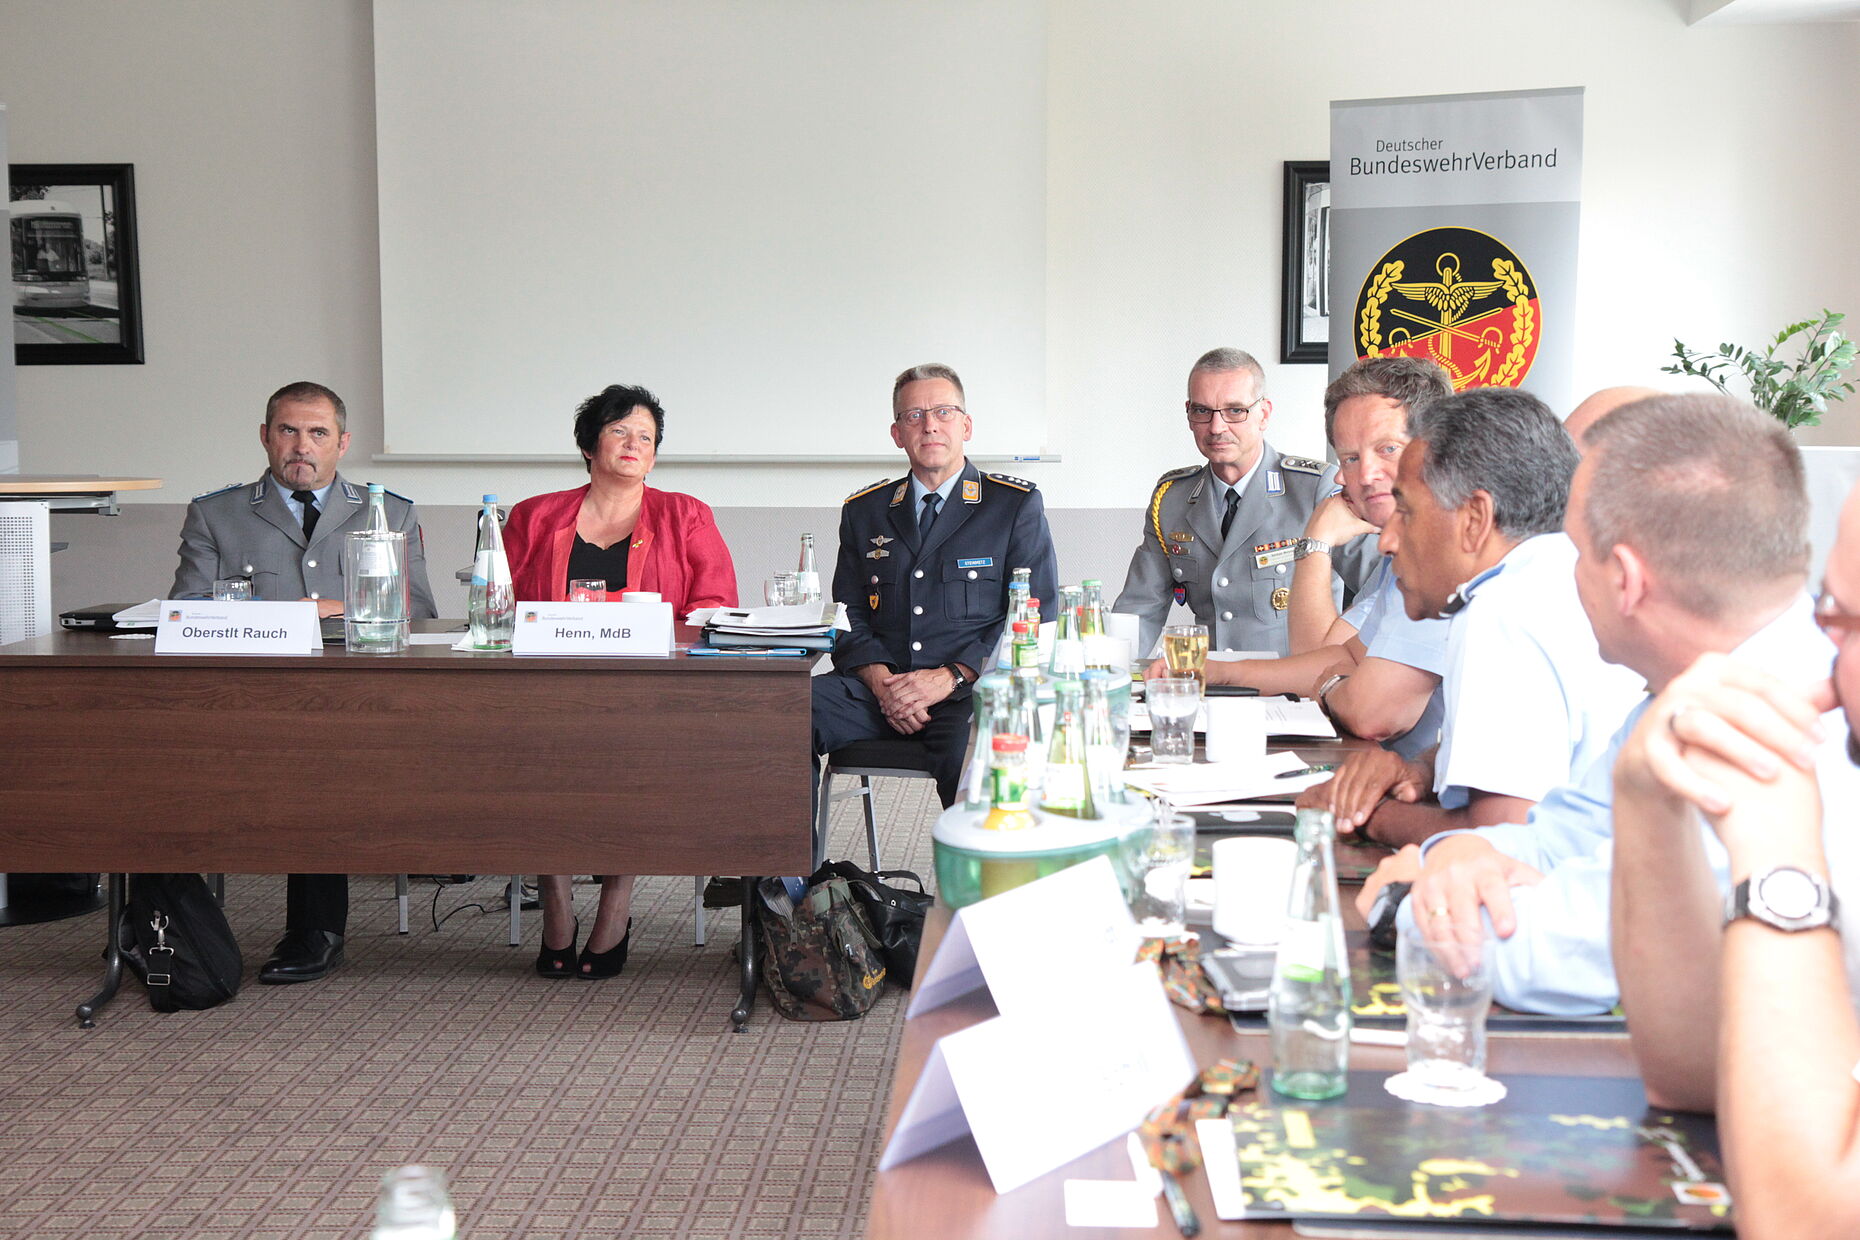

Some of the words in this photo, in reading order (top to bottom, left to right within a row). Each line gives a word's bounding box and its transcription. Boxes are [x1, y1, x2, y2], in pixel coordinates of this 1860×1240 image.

[1376, 137, 1444, 153] Deutscher
[1350, 147, 1558, 176] BundeswehrVerband
[182, 626, 239, 639] Oberstlt
[243, 627, 288, 639] Rauch
[555, 627, 595, 640] Henn,
[600, 628, 631, 639] MdB
